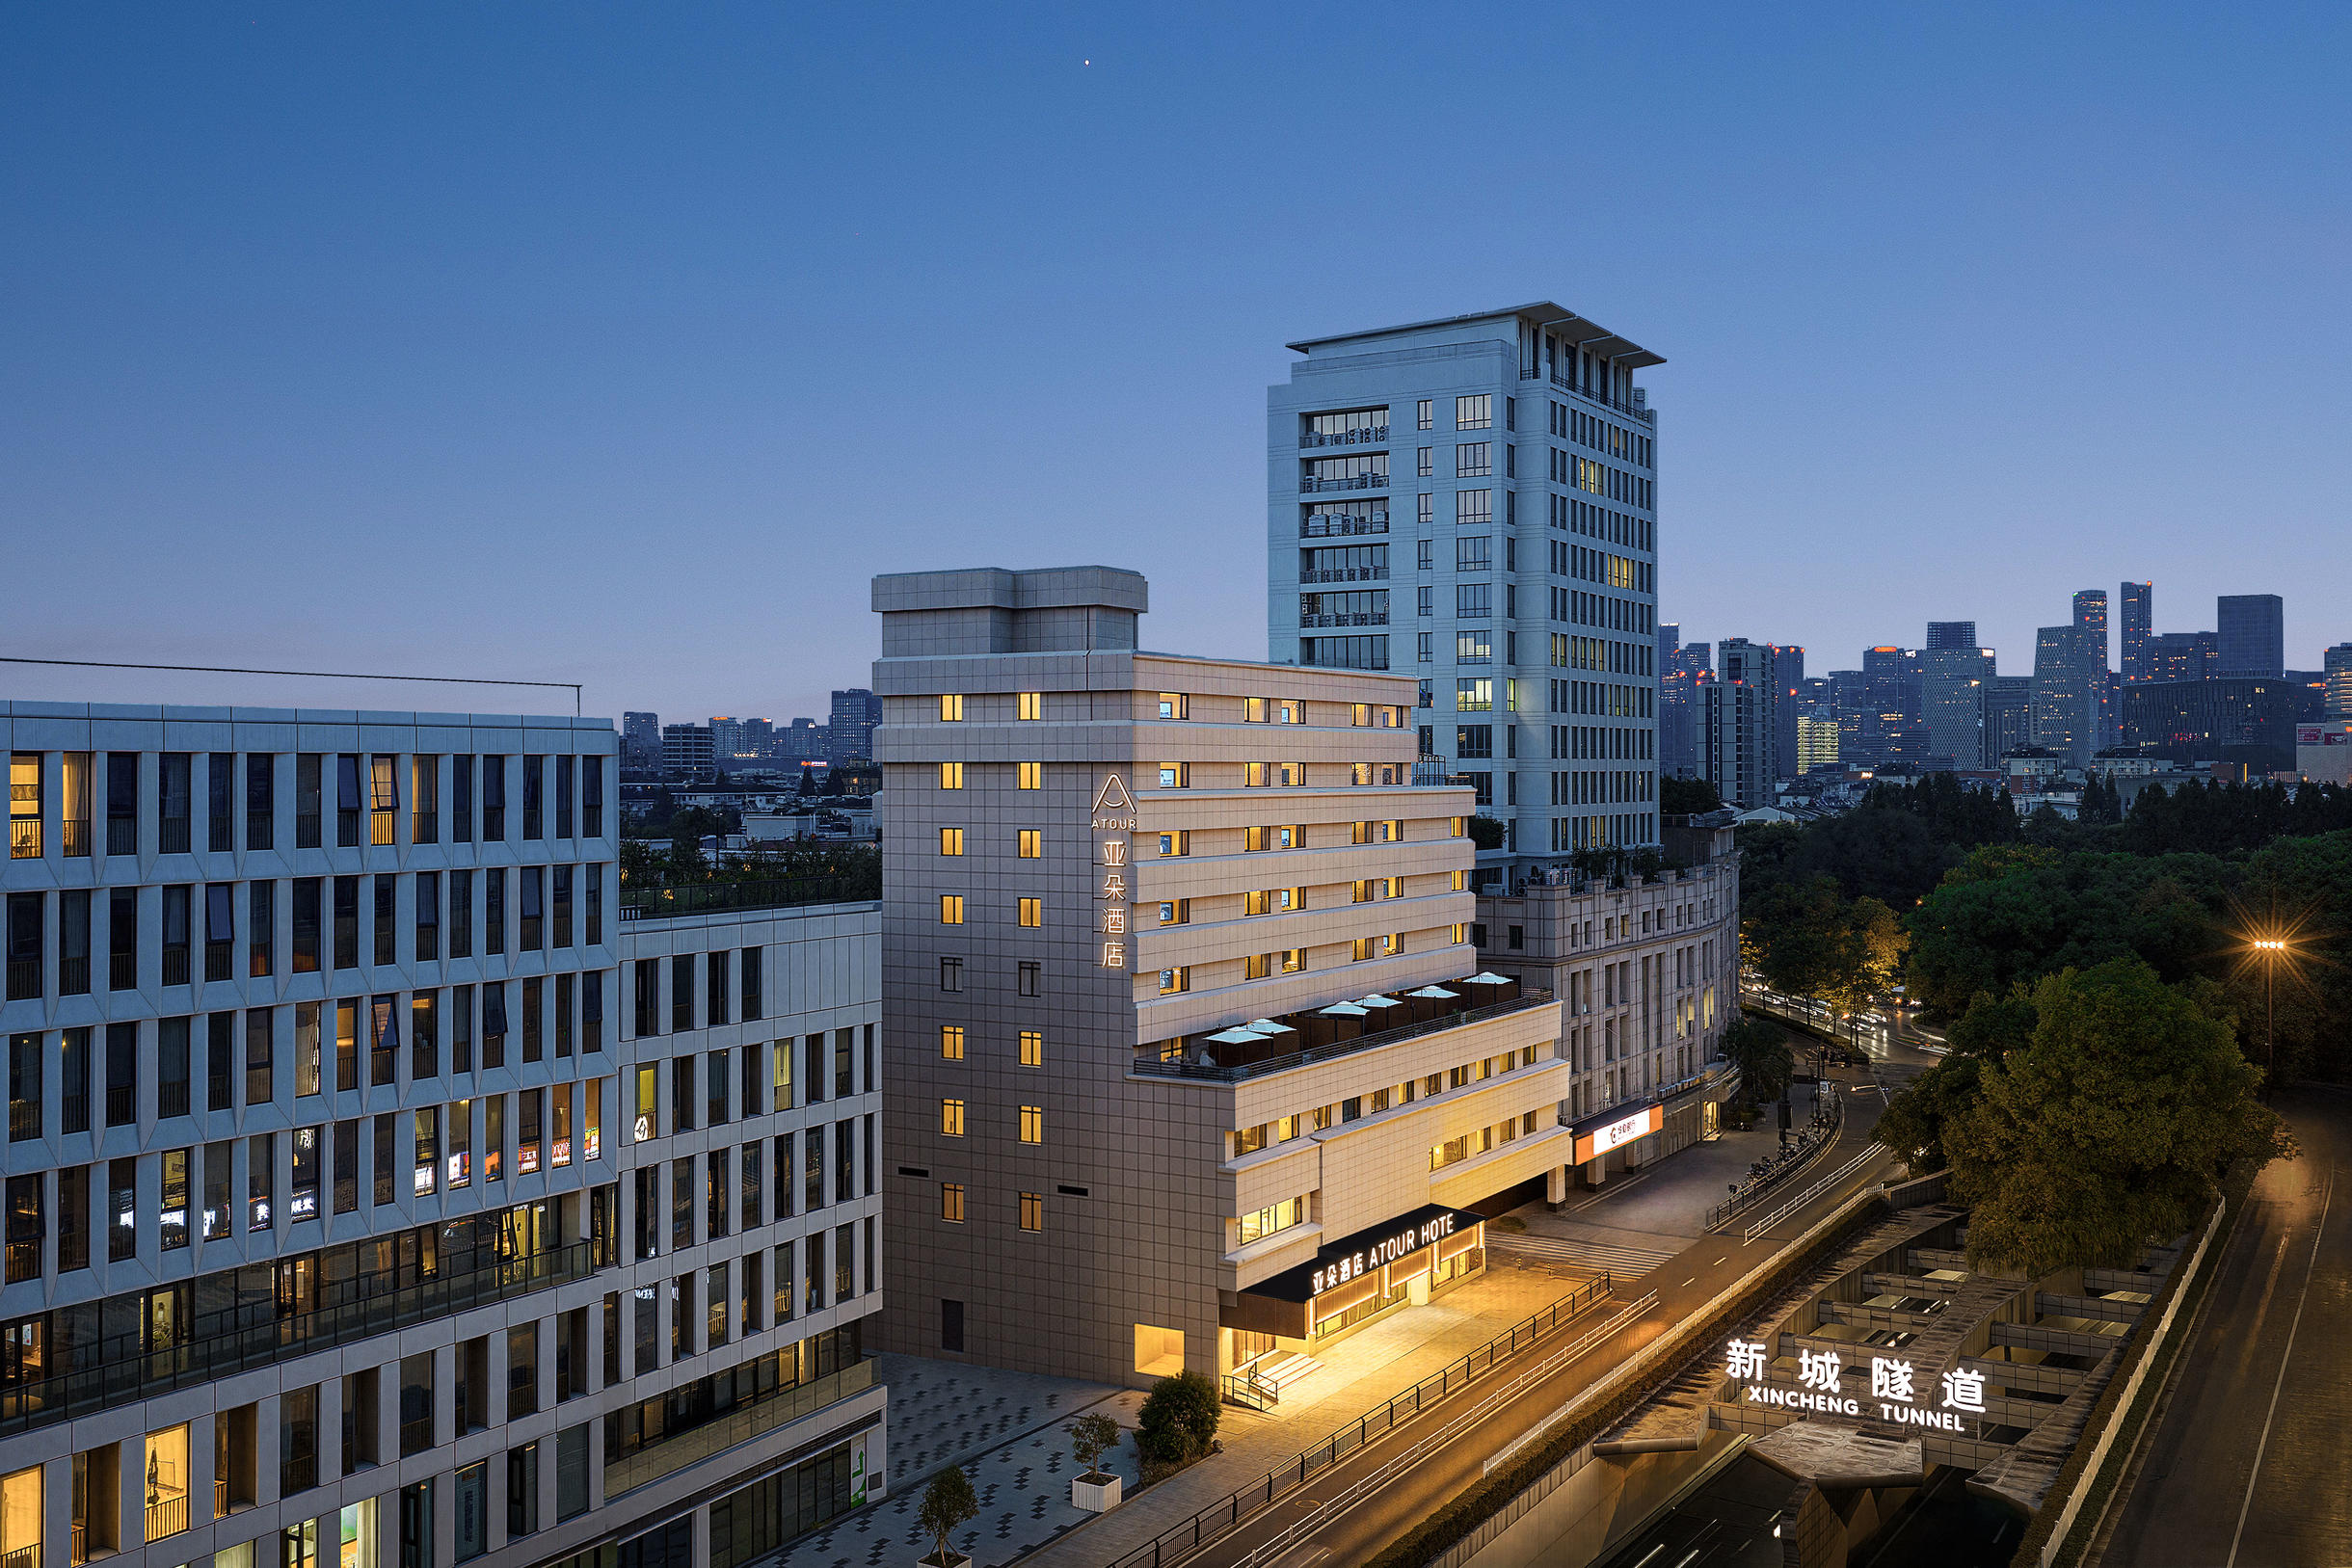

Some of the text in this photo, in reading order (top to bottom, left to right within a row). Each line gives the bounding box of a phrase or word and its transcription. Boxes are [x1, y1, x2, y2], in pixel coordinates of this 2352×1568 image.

[1091, 818, 1136, 831] ATOUR
[1103, 841, 1126, 968] 亚朵酒店
[1313, 1213, 1455, 1295] 亚朵酒店 ATOUR HOTE
[1725, 1339, 1987, 1414] 新城隧道
[1748, 1385, 1965, 1432] XINCHENG TUNNEL
